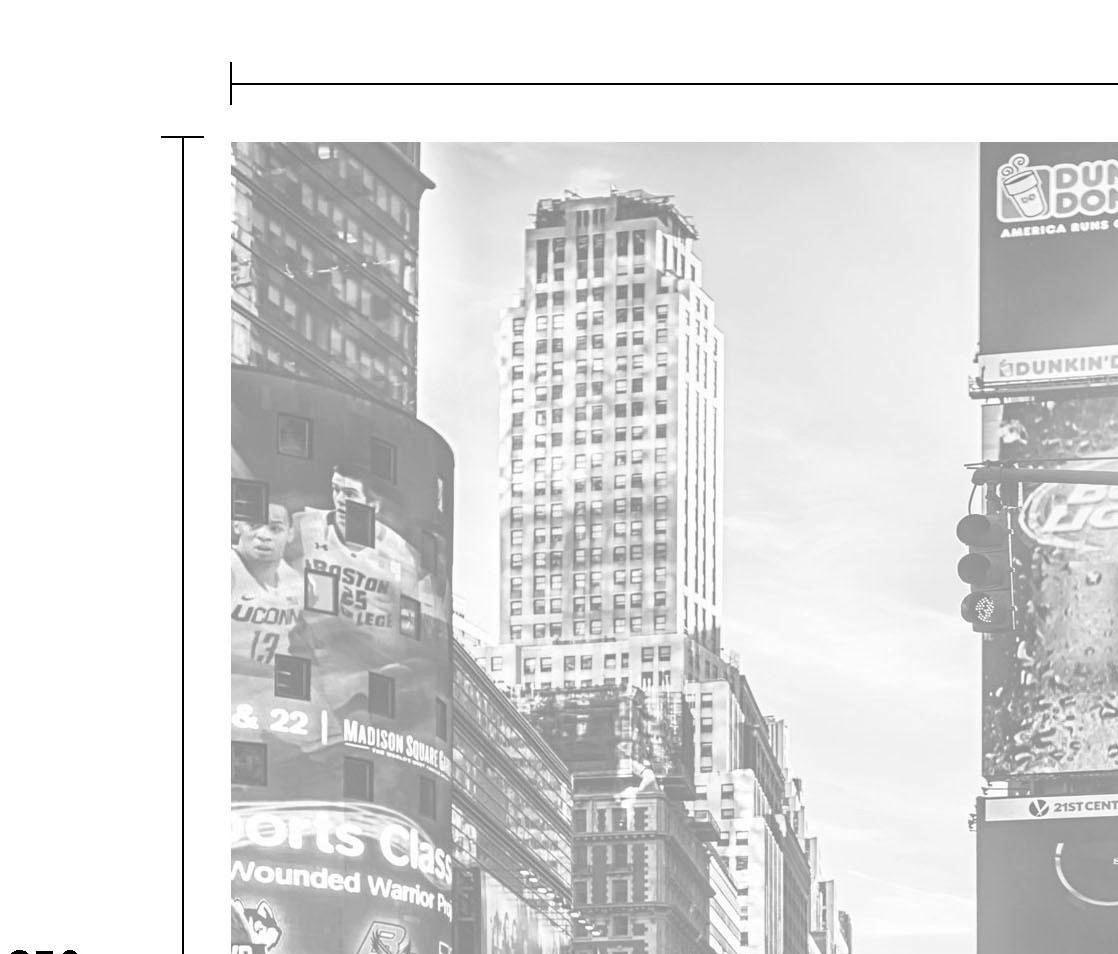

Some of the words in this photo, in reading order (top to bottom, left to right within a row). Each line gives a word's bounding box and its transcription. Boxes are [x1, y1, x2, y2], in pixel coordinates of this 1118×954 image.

[1000, 222, 1067, 239] AMERICA
[1070, 219, 1110, 233] RUNS
[269, 708, 309, 736] 22
[343, 718, 404, 755] MADISON
[405, 734, 439, 769] SQUARE
[1054, 801, 1085, 813] 21ST
[231, 860, 361, 894] Wounded
[367, 874, 435, 909] Warrior
